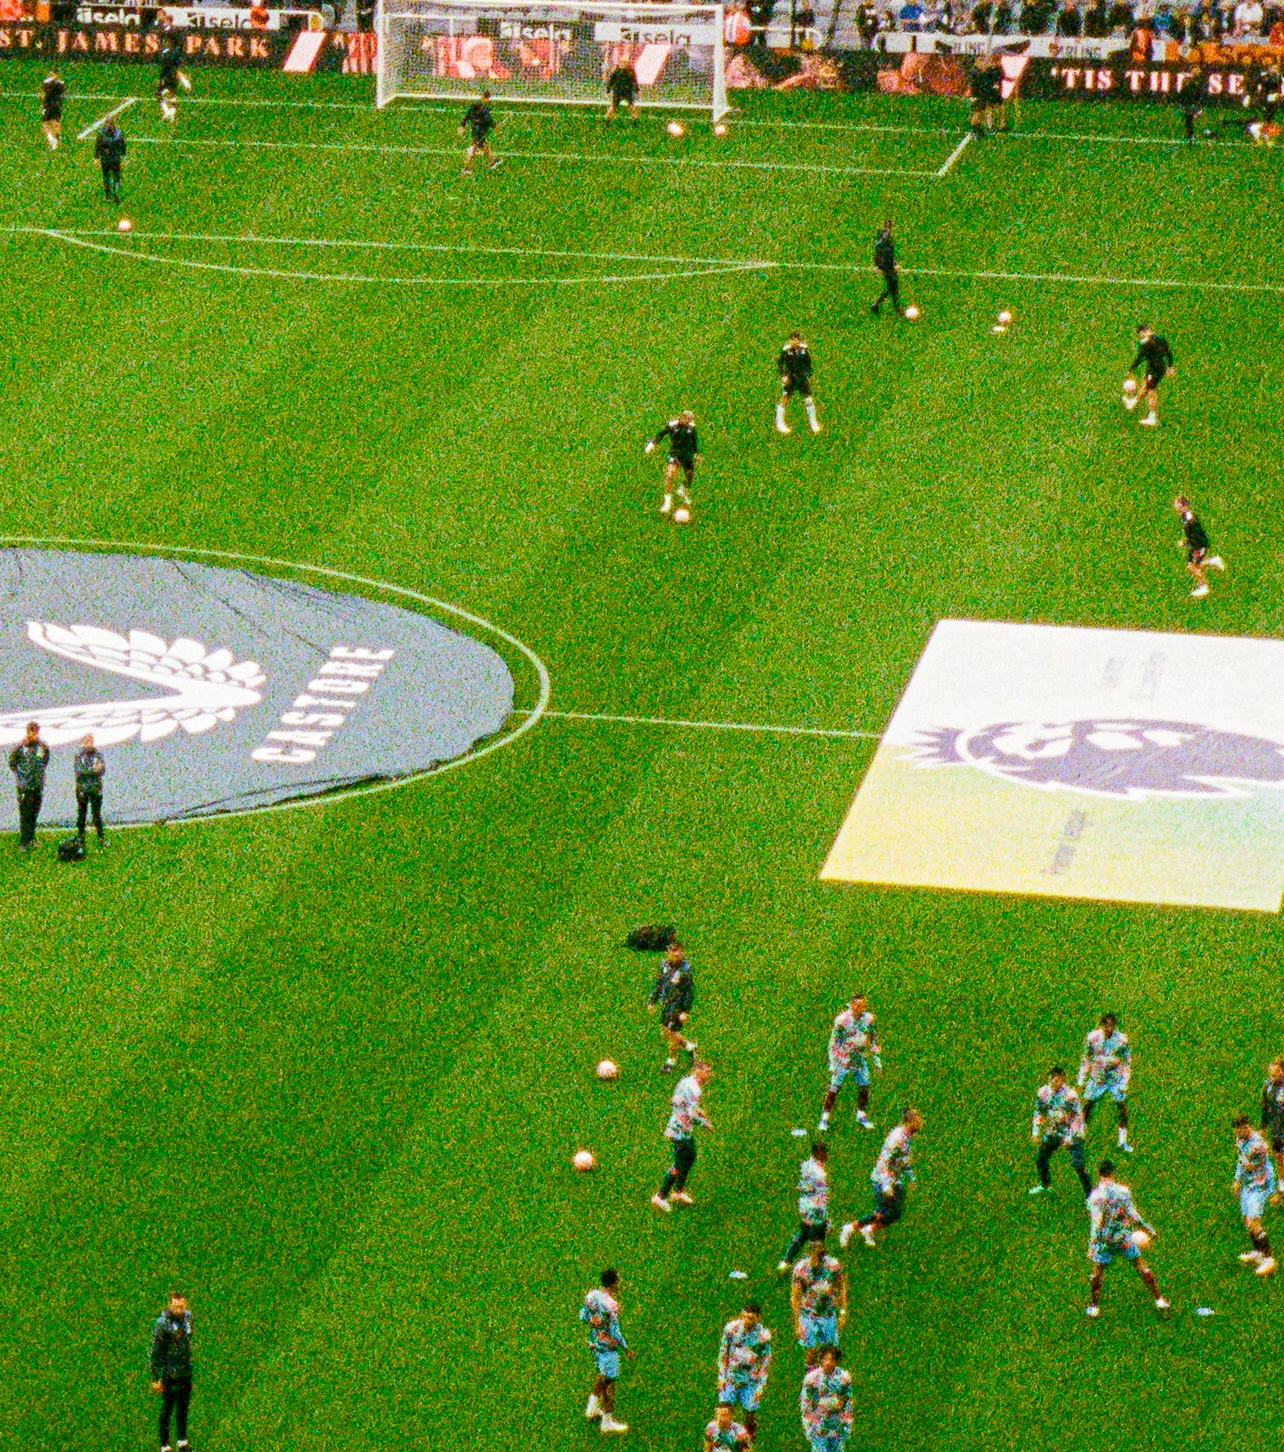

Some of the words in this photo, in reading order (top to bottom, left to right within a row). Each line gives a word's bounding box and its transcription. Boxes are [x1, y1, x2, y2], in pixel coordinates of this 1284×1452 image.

[185, 36, 269, 58] PARK
[1050, 68, 1113, 91] 'TIS
[251, 646, 396, 763] CASTORE
